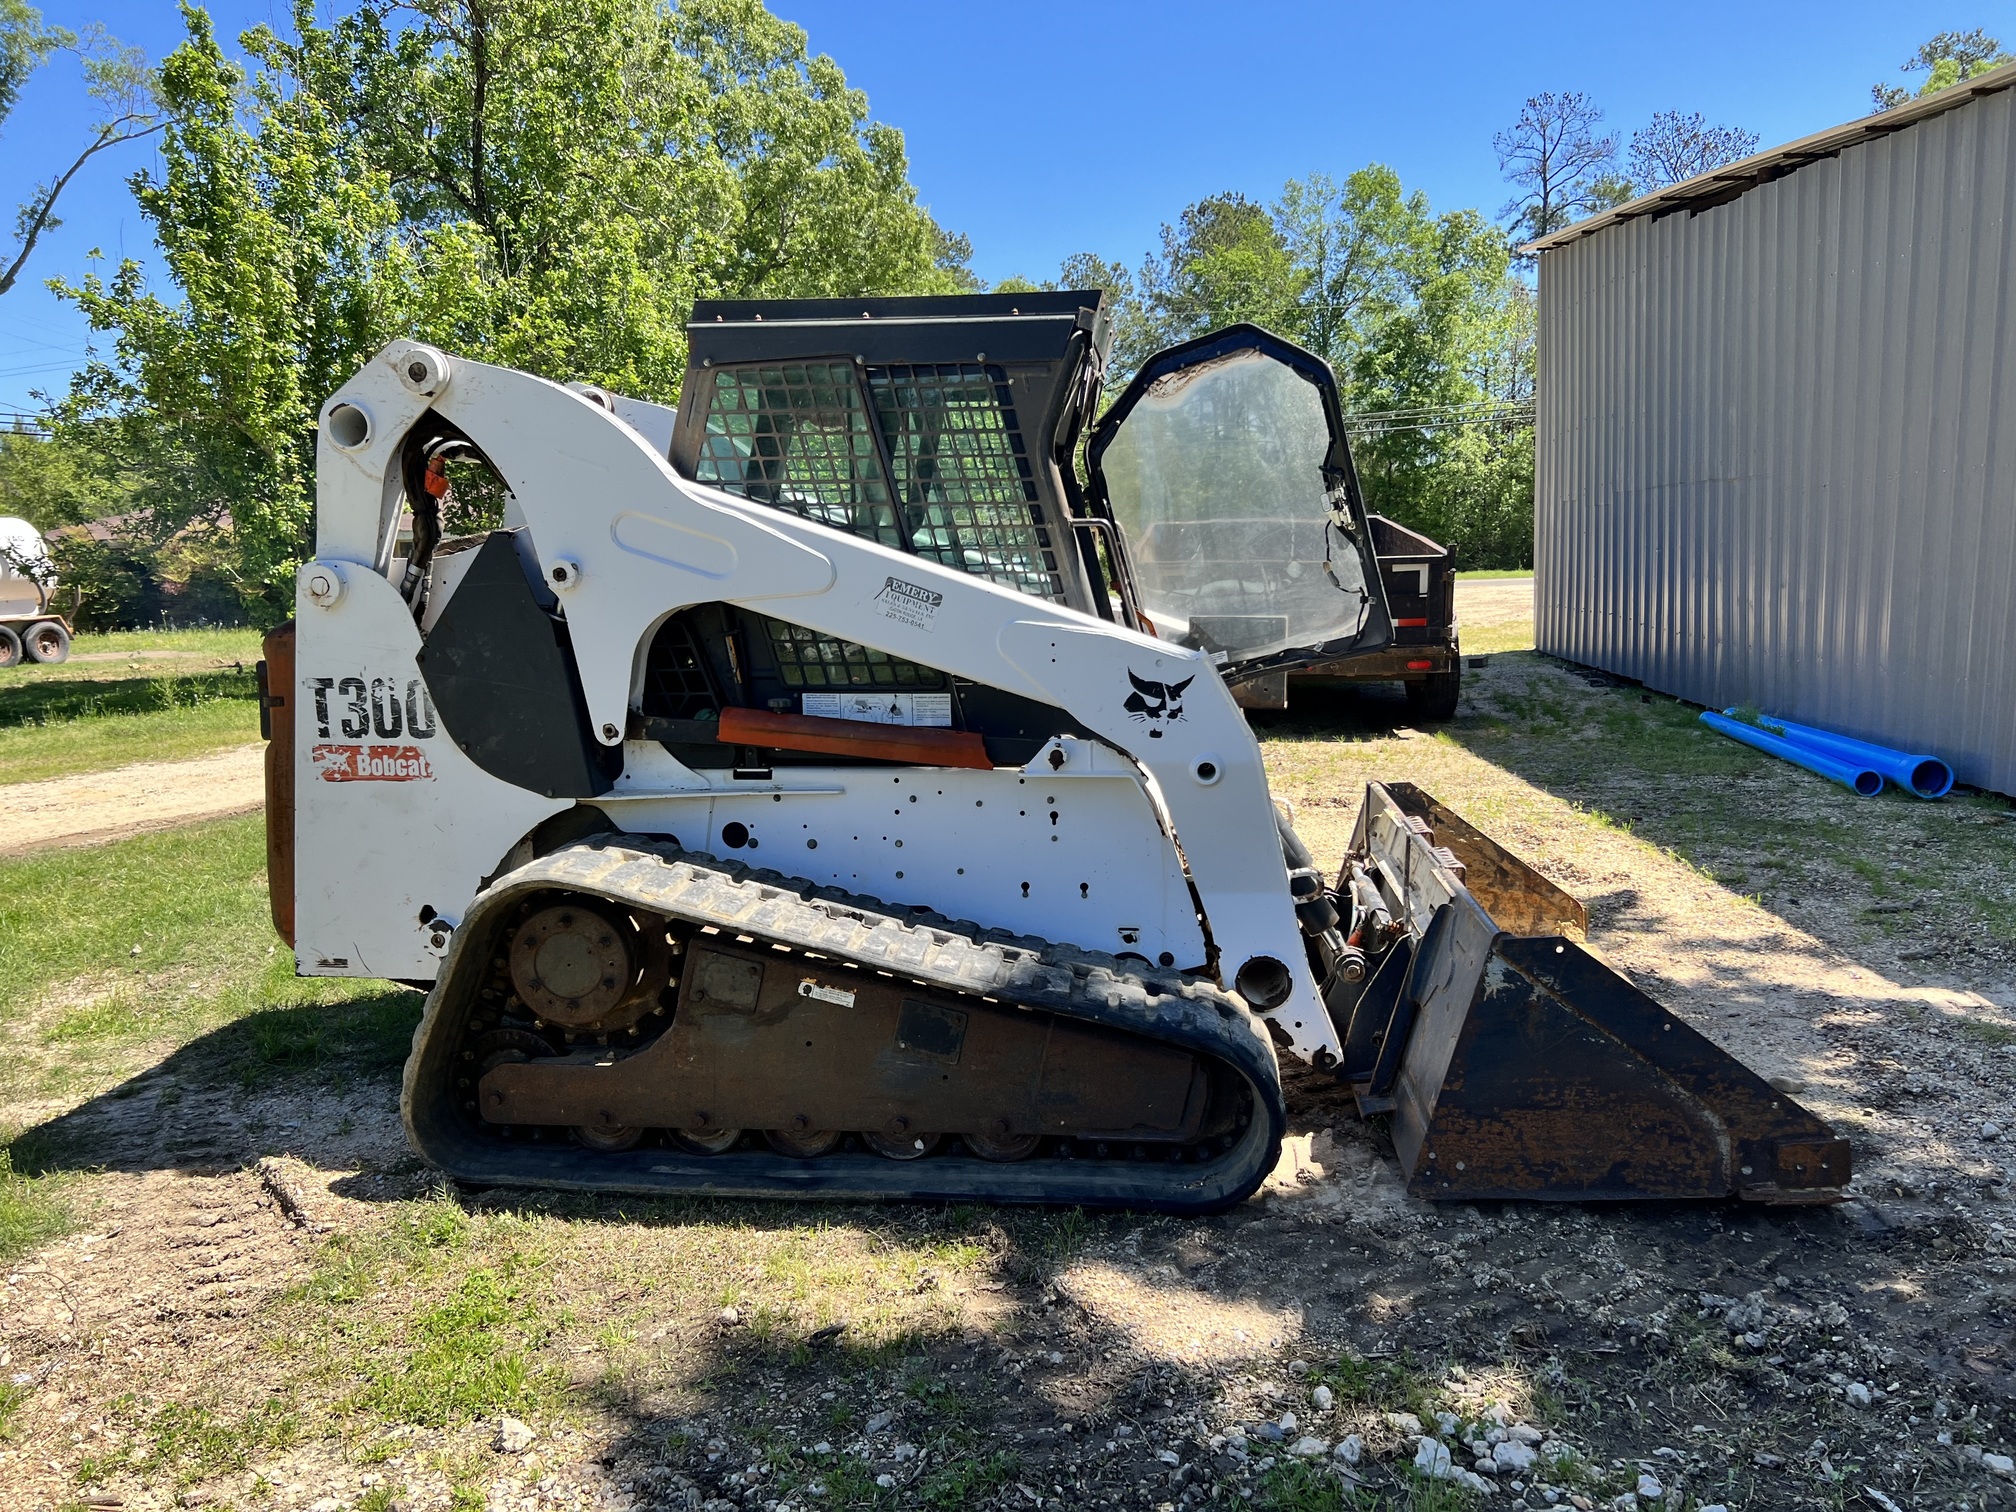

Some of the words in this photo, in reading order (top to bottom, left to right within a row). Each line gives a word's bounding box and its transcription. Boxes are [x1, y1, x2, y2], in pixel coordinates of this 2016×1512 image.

[891, 580, 938, 603] EMERY
[303, 677, 436, 739] T300
[356, 754, 427, 777] Bobcat
